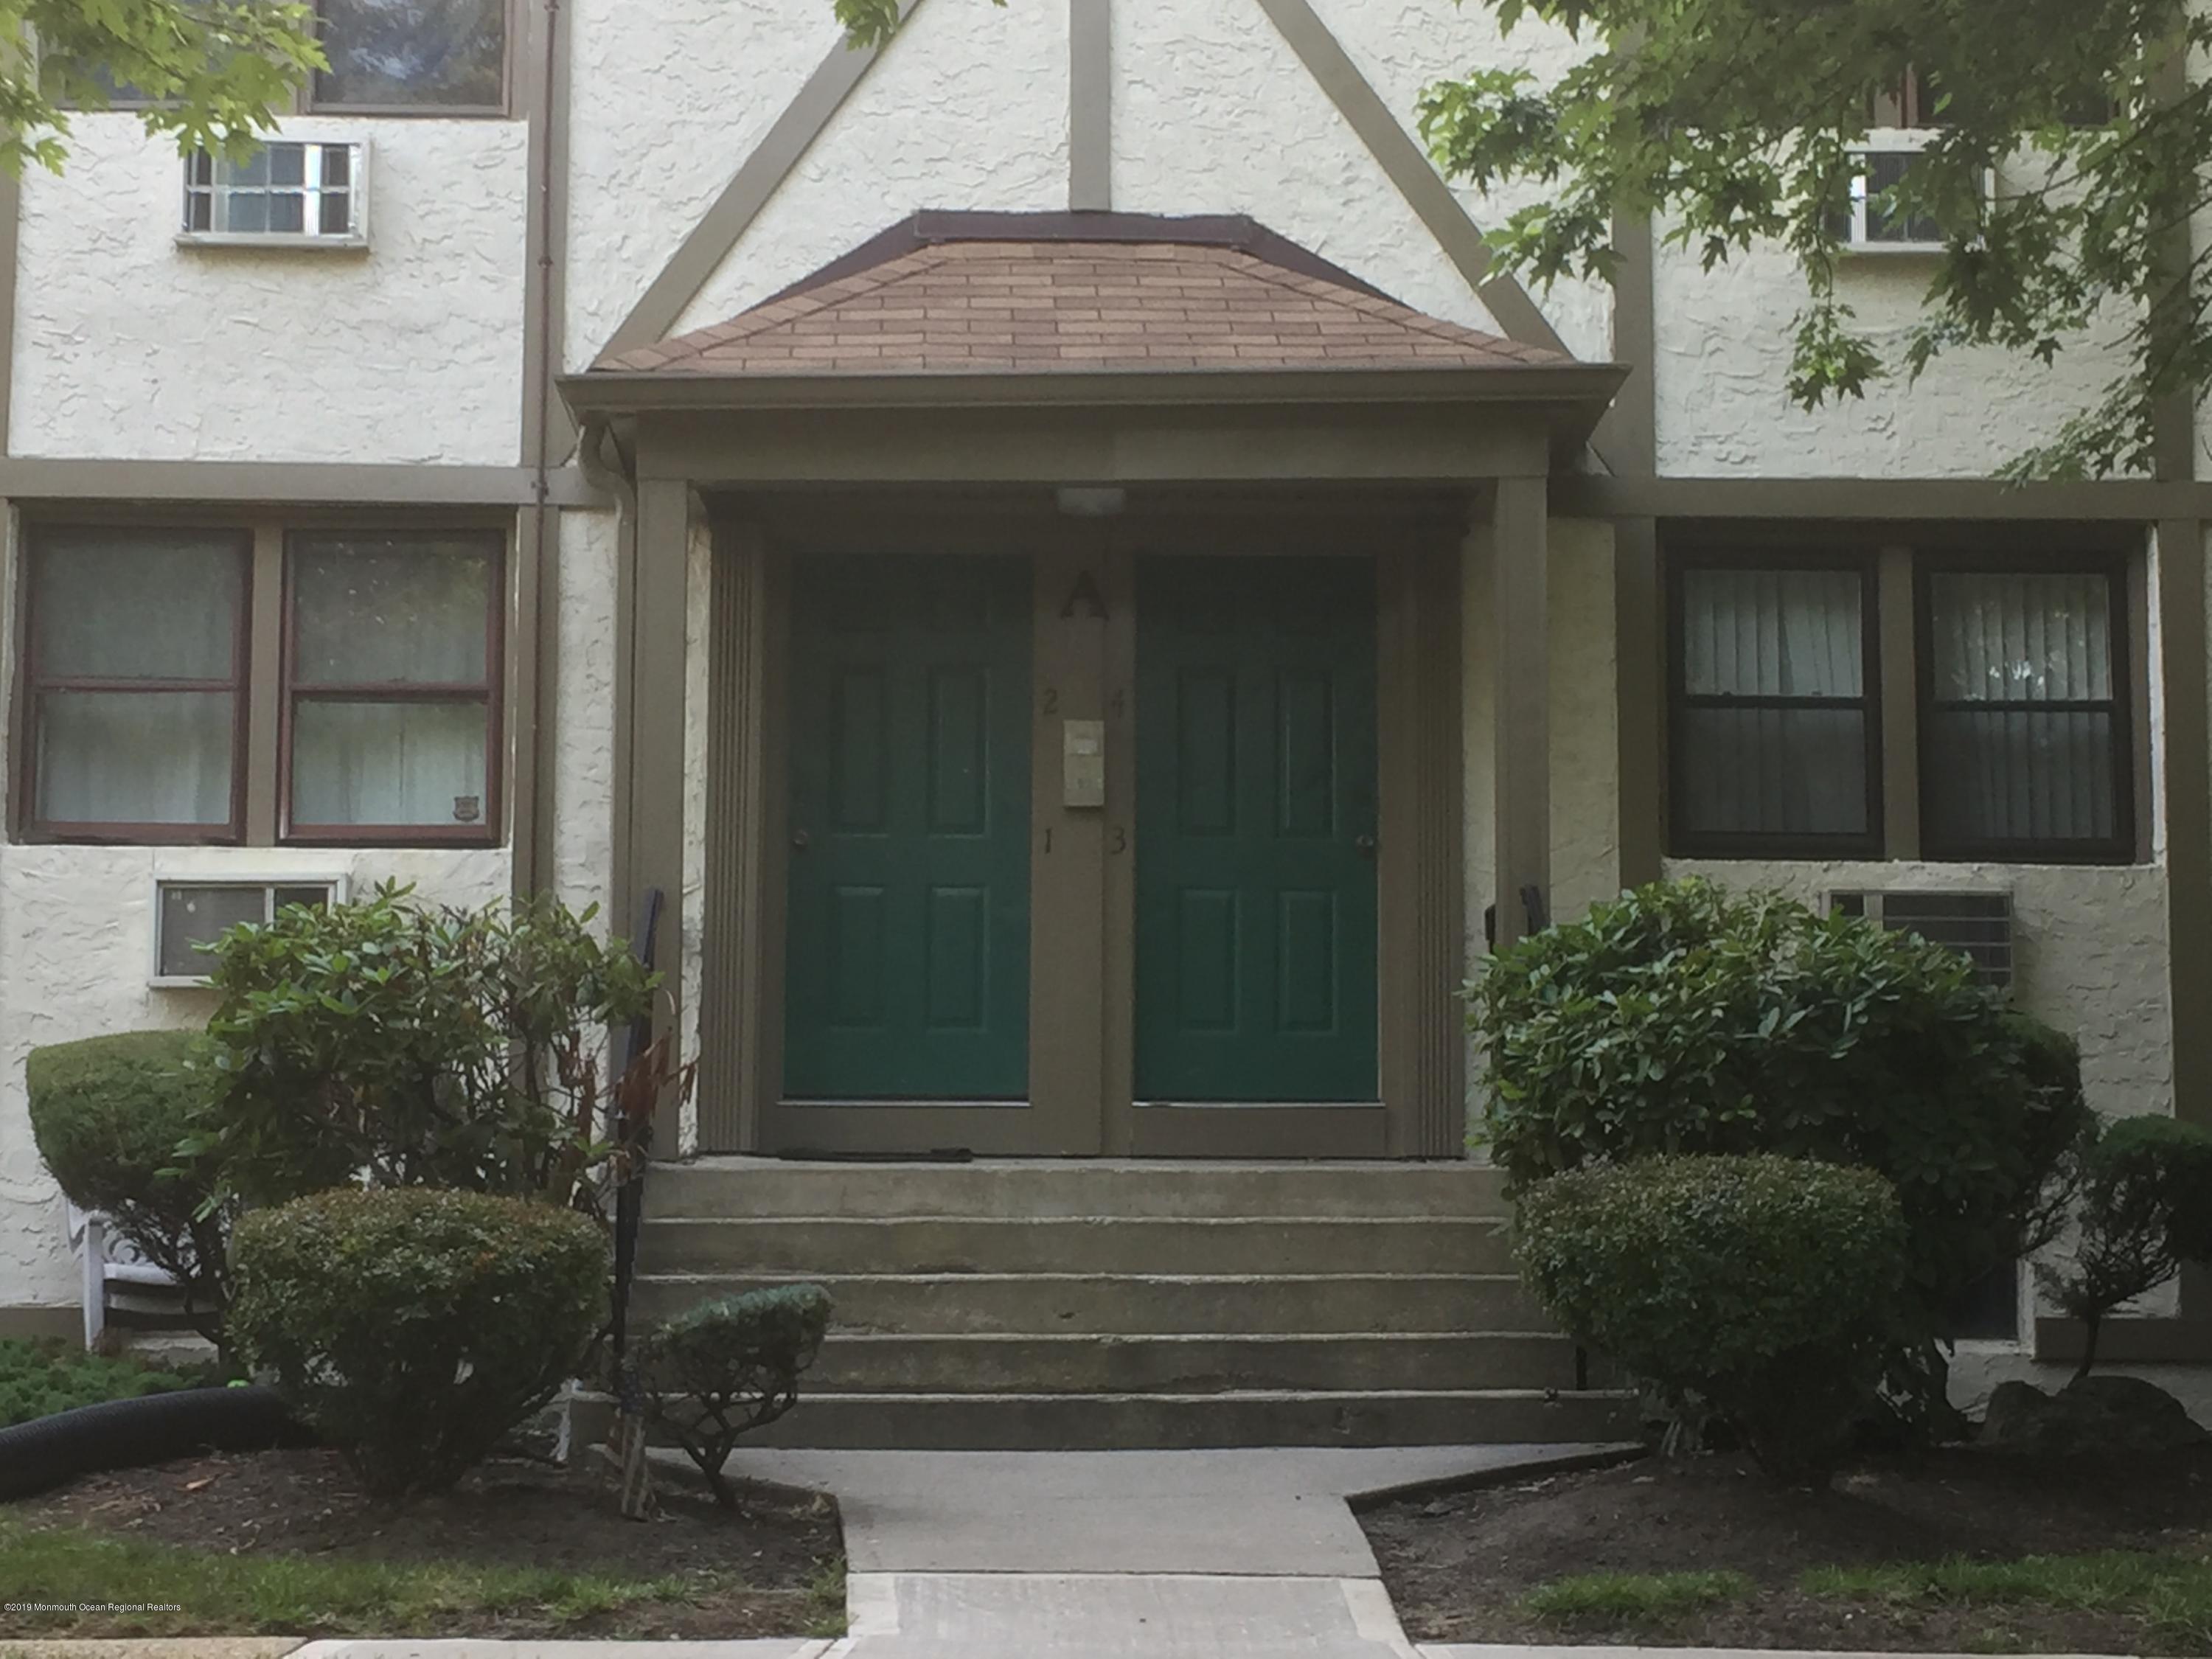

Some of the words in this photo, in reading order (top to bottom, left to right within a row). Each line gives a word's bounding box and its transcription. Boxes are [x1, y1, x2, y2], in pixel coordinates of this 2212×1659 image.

[1060, 570, 1109, 619] A
[1043, 688, 1058, 715] 2
[1111, 689, 1125, 718] 4
[1043, 827, 1052, 854] 1
[1111, 827, 1126, 855] 3
